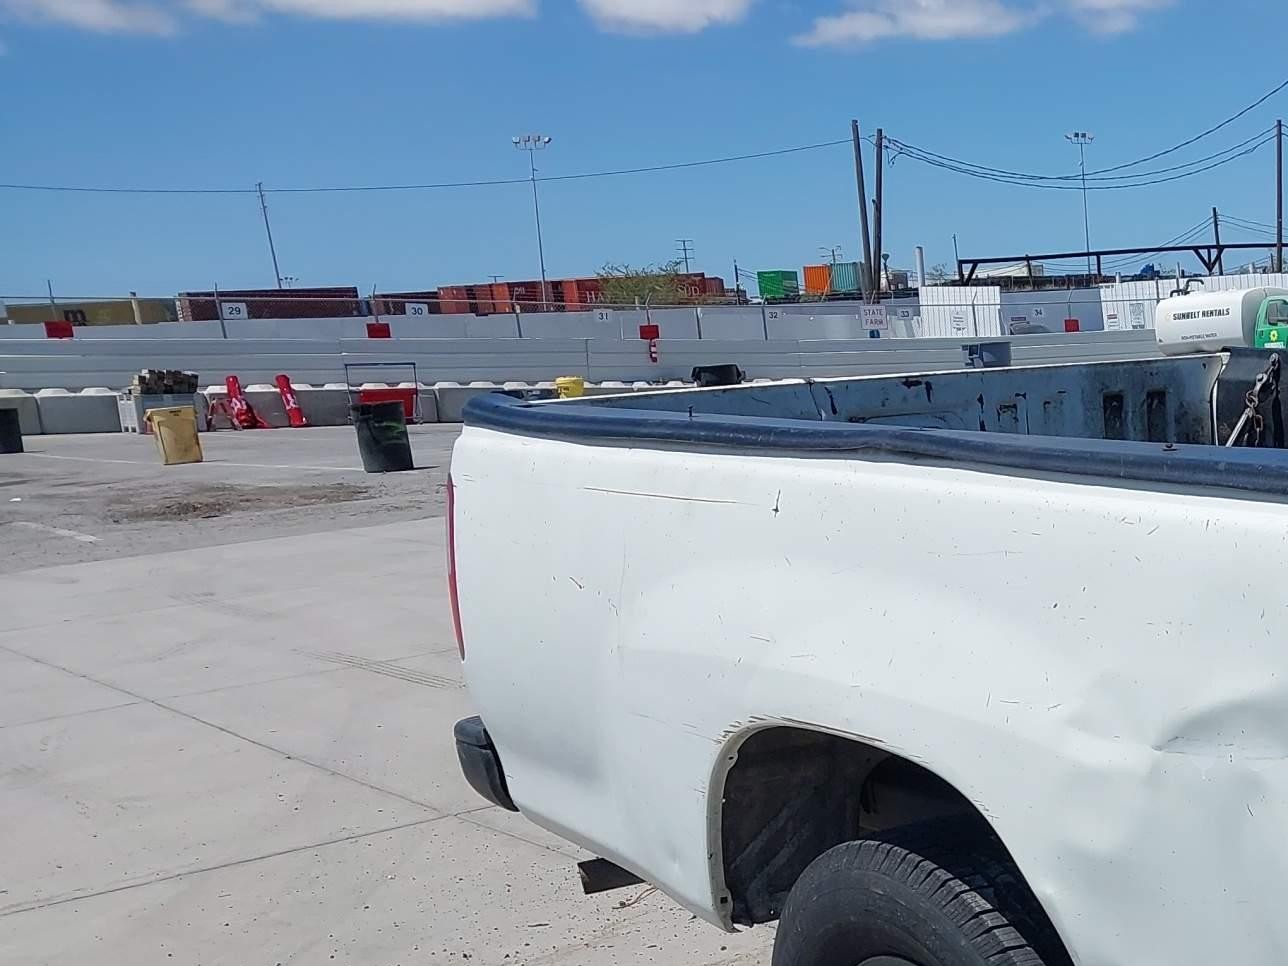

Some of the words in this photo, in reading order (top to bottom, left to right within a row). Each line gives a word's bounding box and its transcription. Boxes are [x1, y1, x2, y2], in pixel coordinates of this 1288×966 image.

[228, 306, 241, 315] 29
[411, 307, 423, 316] 30
[863, 309, 883, 317] STATE
[901, 310, 910, 318] 33
[1173, 310, 1201, 321] SUNBELT
[1202, 307, 1230, 318] RENTALS
[598, 312, 608, 321] 31
[768, 311, 778, 319] 32
[865, 318, 884, 326] FARM
